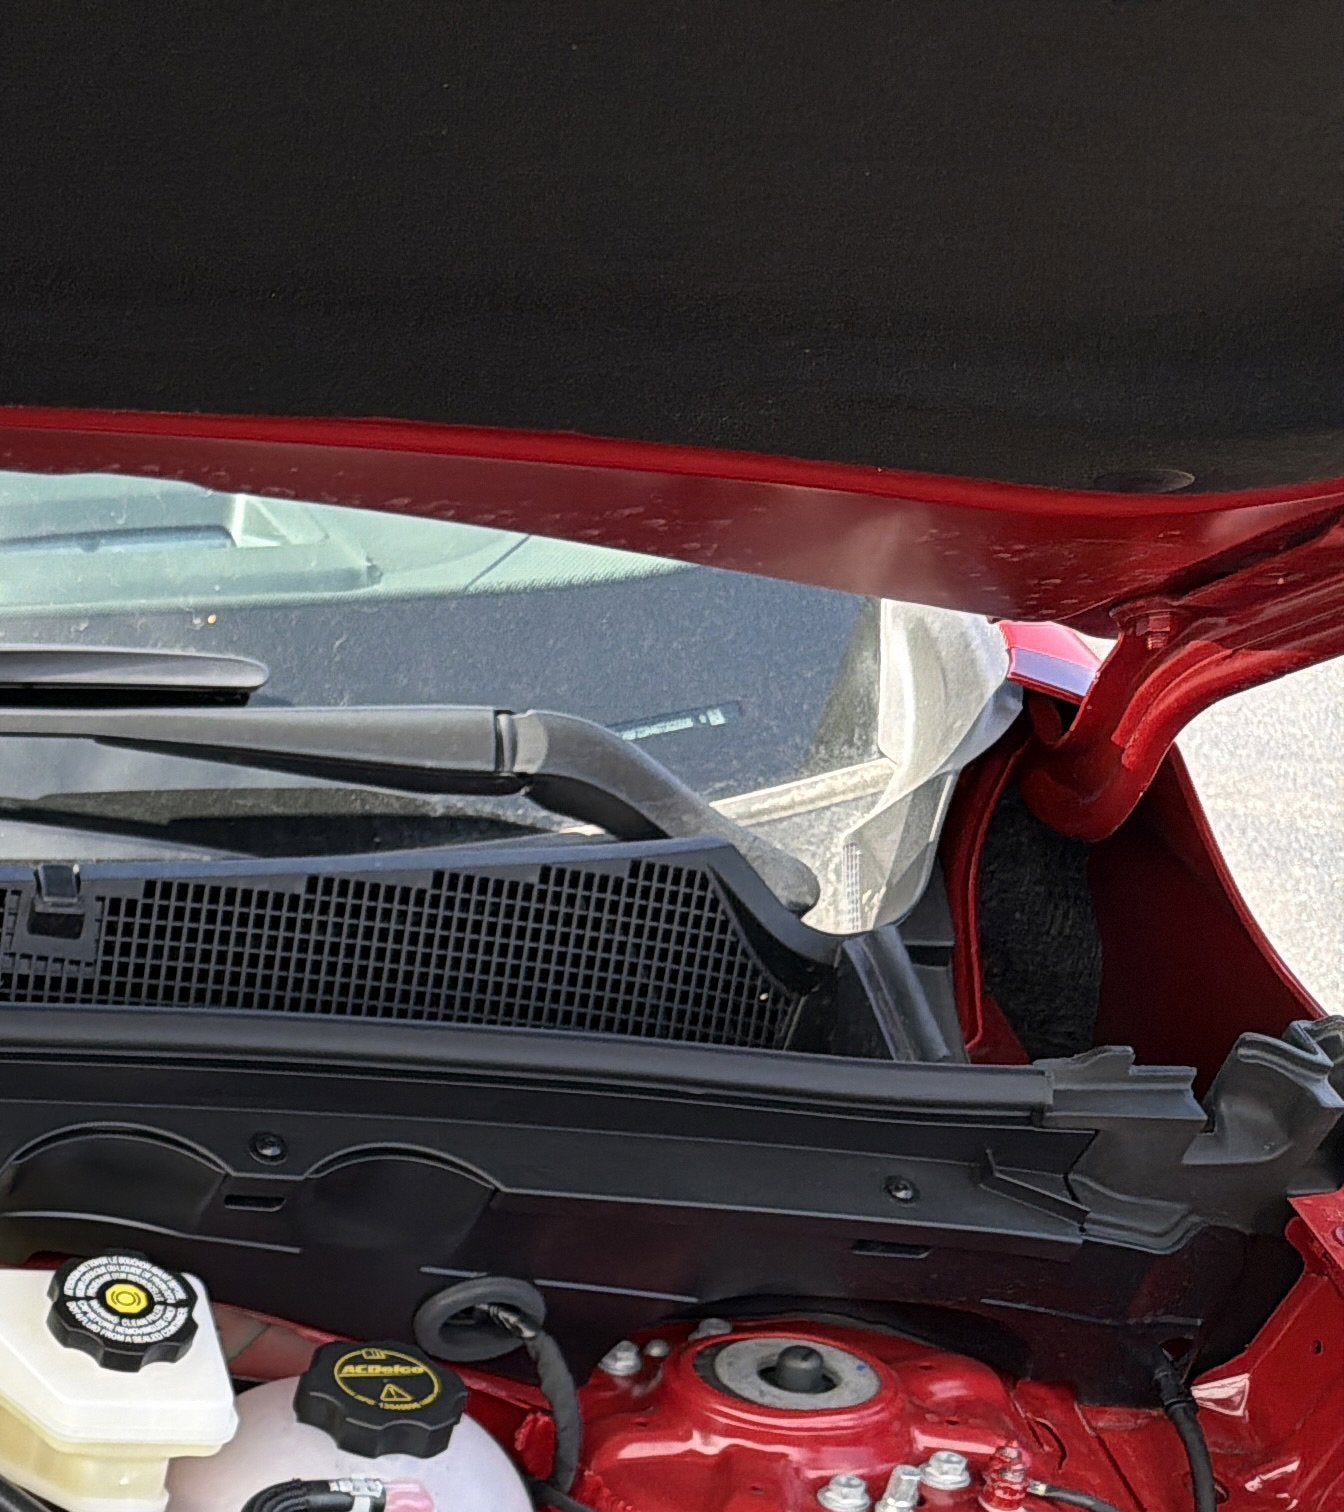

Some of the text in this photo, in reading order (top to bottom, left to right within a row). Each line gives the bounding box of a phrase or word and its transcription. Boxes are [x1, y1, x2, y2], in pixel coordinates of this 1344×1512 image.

[97, 1329, 124, 1343] FROM
[124, 1335, 131, 1344] A
[341, 1364, 425, 1375] ACDelco
